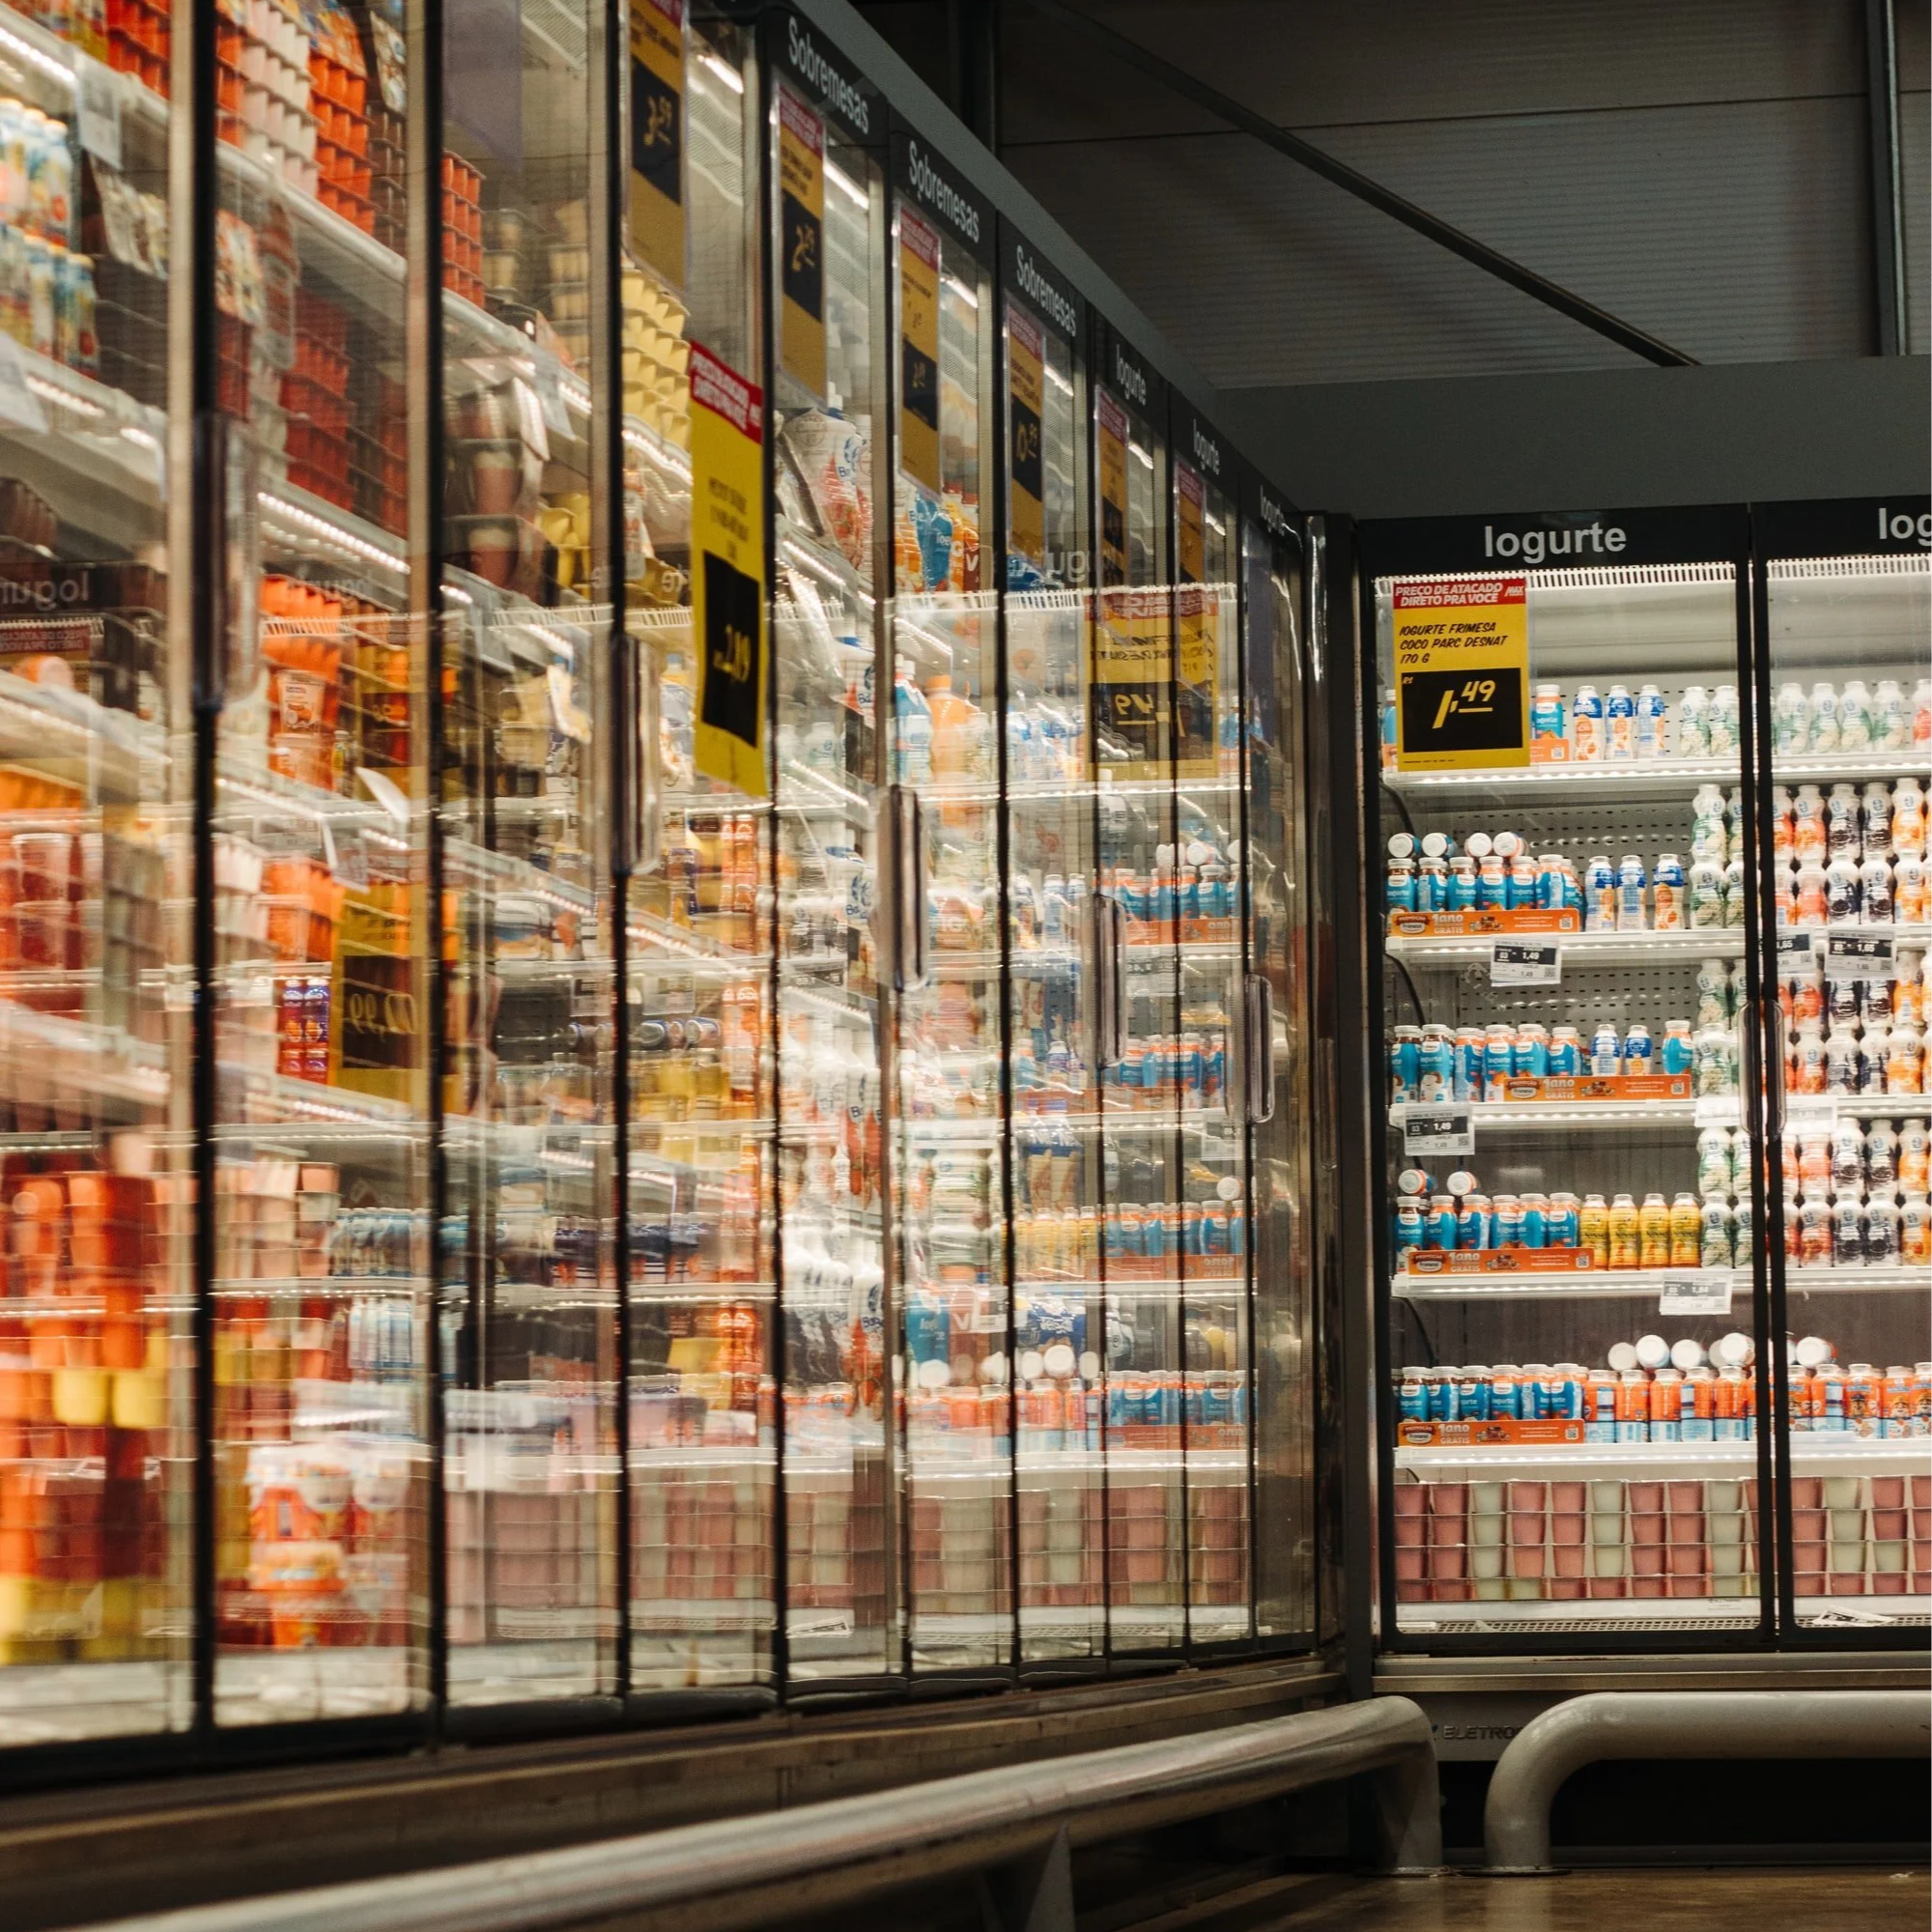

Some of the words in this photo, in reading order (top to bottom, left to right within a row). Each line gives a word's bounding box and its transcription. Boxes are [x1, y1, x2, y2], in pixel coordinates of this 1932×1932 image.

[788, 16, 868, 134] Sobremesas
[909, 140, 980, 242] Sobremesas
[1016, 244, 1076, 337] Sobremesas
[1117, 344, 1147, 406] Iogurte
[1485, 522, 1628, 564] Iogurte
[1878, 507, 1932, 546] Iog
[1396, 585, 1432, 597] PREÇO
[1434, 584, 1450, 595] DE
[1450, 582, 1503, 594] ATACADO
[1401, 596, 1442, 607] DIRETO
[1443, 594, 1468, 605] PRA
[1400, 624, 1446, 636] IOGURTE
[1449, 622, 1496, 634] FRIMESA
[1400, 639, 1428, 650] COCO
[1432, 638, 1462, 649] PARC
[1464, 635, 1508, 647] DESNAT
[1400, 653, 1418, 664] 170
[1422, 653, 1431, 664] G
[1432, 680, 1496, 729] 1,49
[1443, 1724, 1524, 1740] ELETRO
